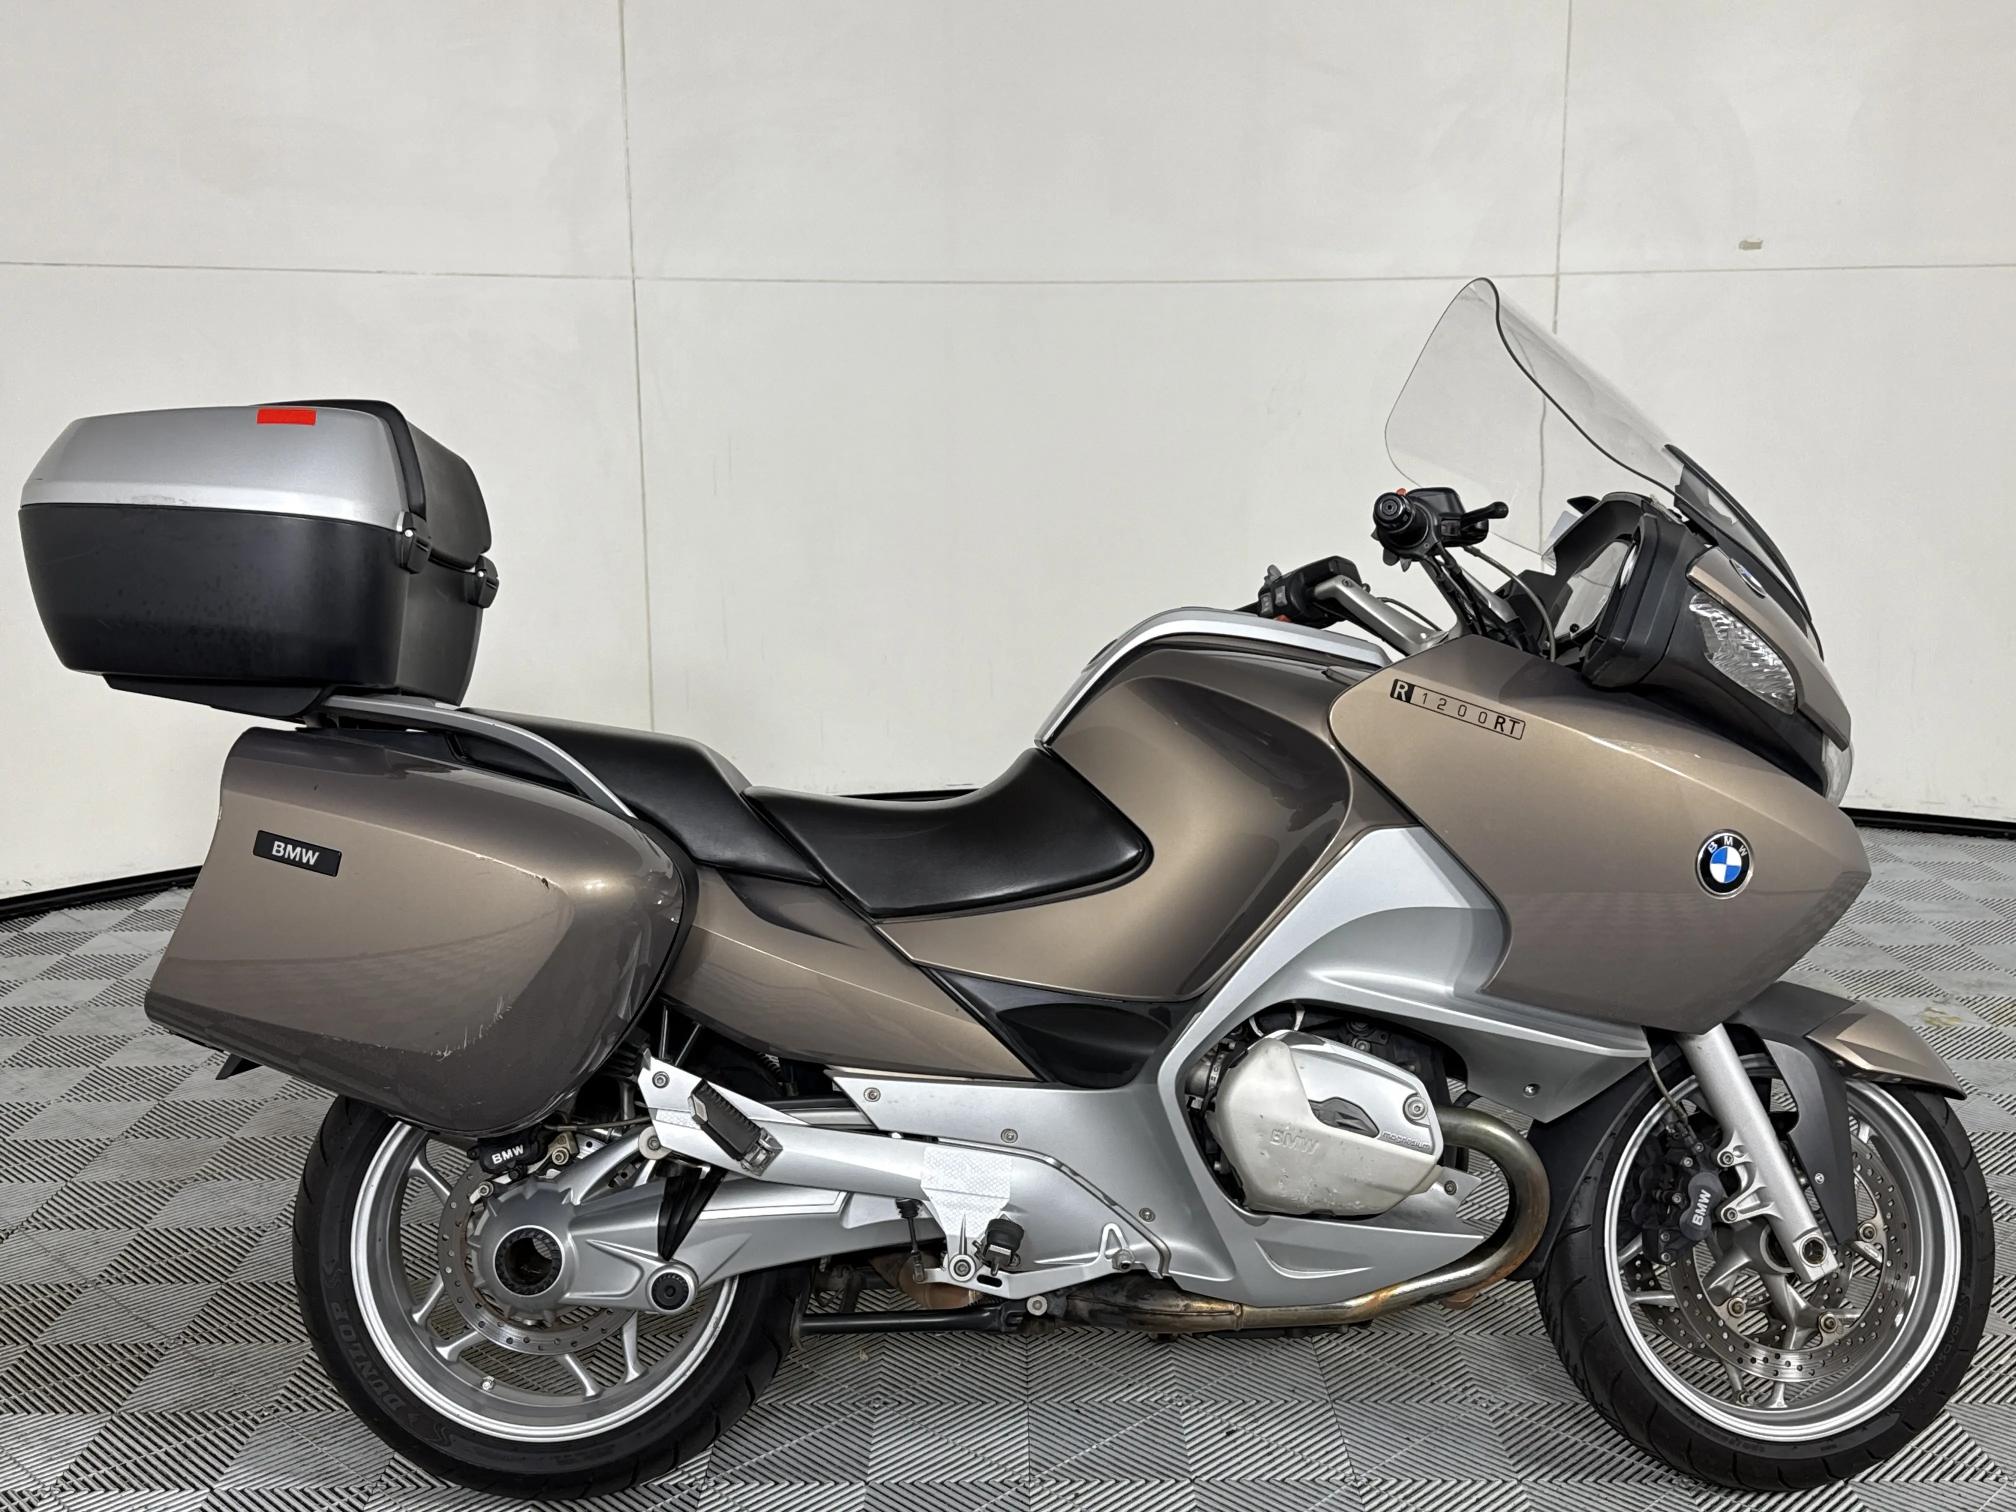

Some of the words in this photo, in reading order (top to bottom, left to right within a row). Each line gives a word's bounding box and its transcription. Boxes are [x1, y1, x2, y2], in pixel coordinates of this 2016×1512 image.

[1394, 681, 1409, 701] R
[271, 840, 320, 866] BMW
[1707, 835, 1748, 857] BMW
[491, 1144, 525, 1165] BMW
[1270, 1129, 1320, 1155] BMW
[1691, 1189, 1712, 1226] BMW
[331, 1302, 406, 1411] DUNLOP
